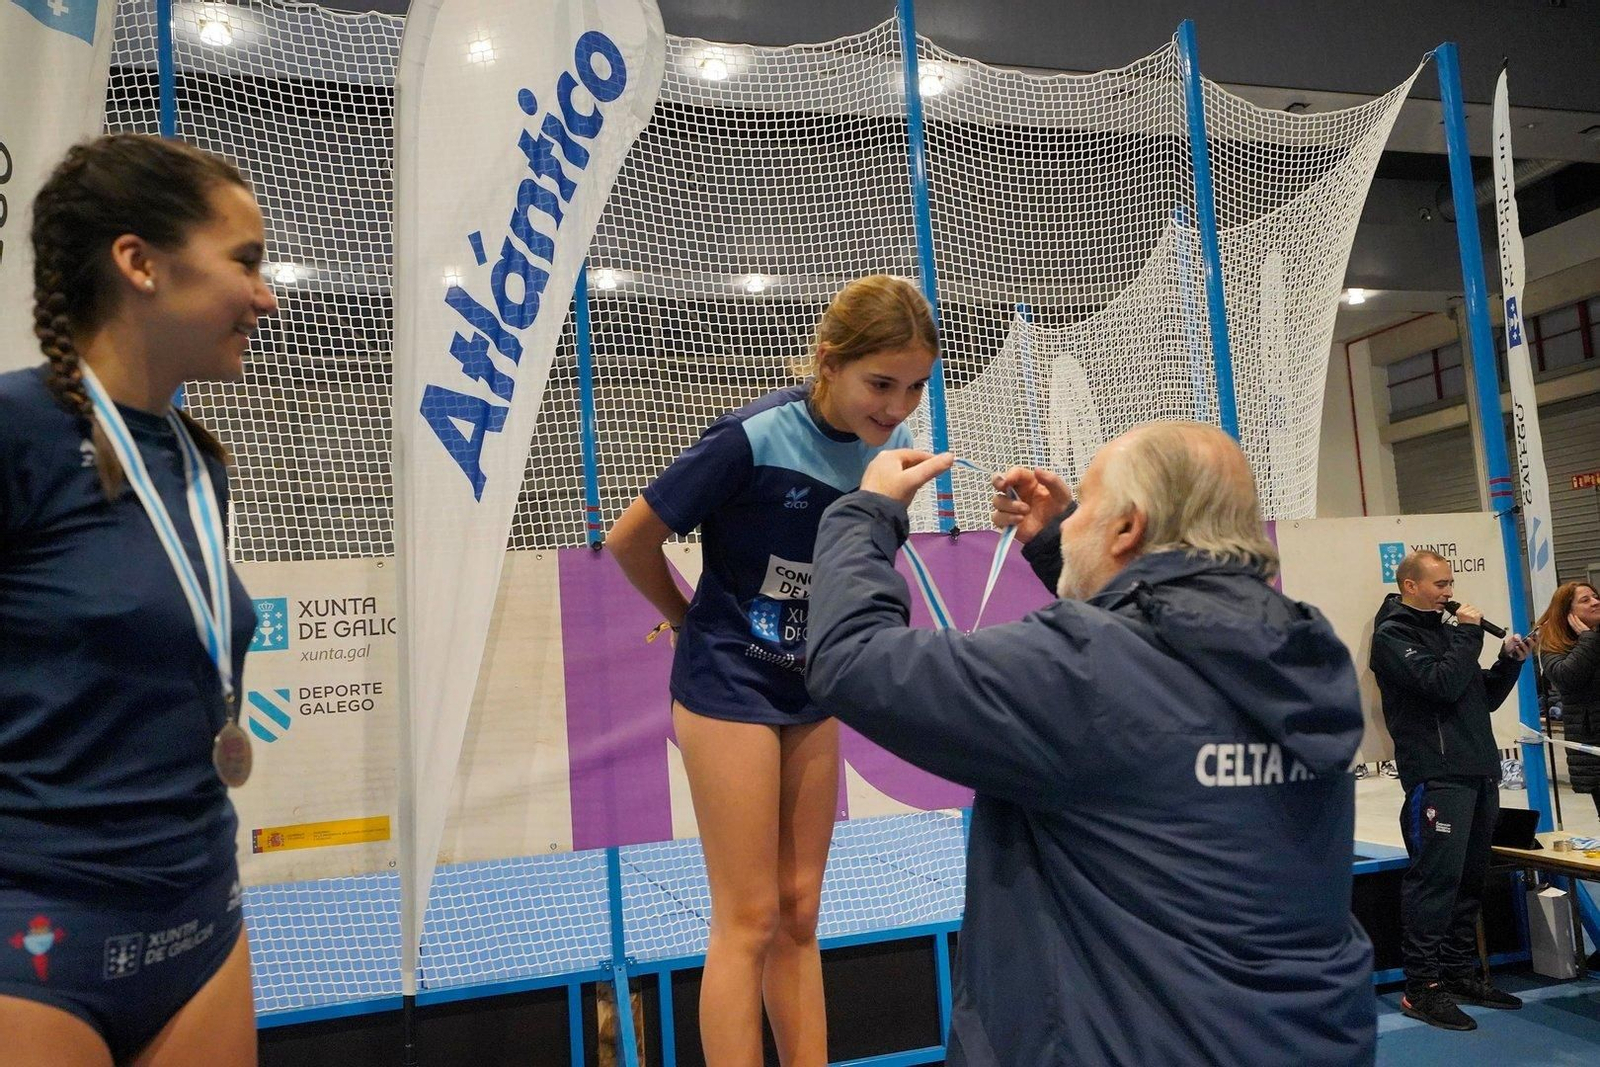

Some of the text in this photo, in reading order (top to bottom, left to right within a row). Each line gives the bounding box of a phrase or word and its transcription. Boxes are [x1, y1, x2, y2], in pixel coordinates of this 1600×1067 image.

[420, 30, 627, 503] Atlántico
[779, 582, 802, 599] DE
[298, 597, 377, 618] XUNTA
[298, 617, 397, 640] DE GALIC
[300, 643, 371, 662] xunta.gal
[299, 682, 383, 700] DEPORTE
[299, 698, 375, 716] GALEGO
[1195, 743, 1284, 787] CELTA
